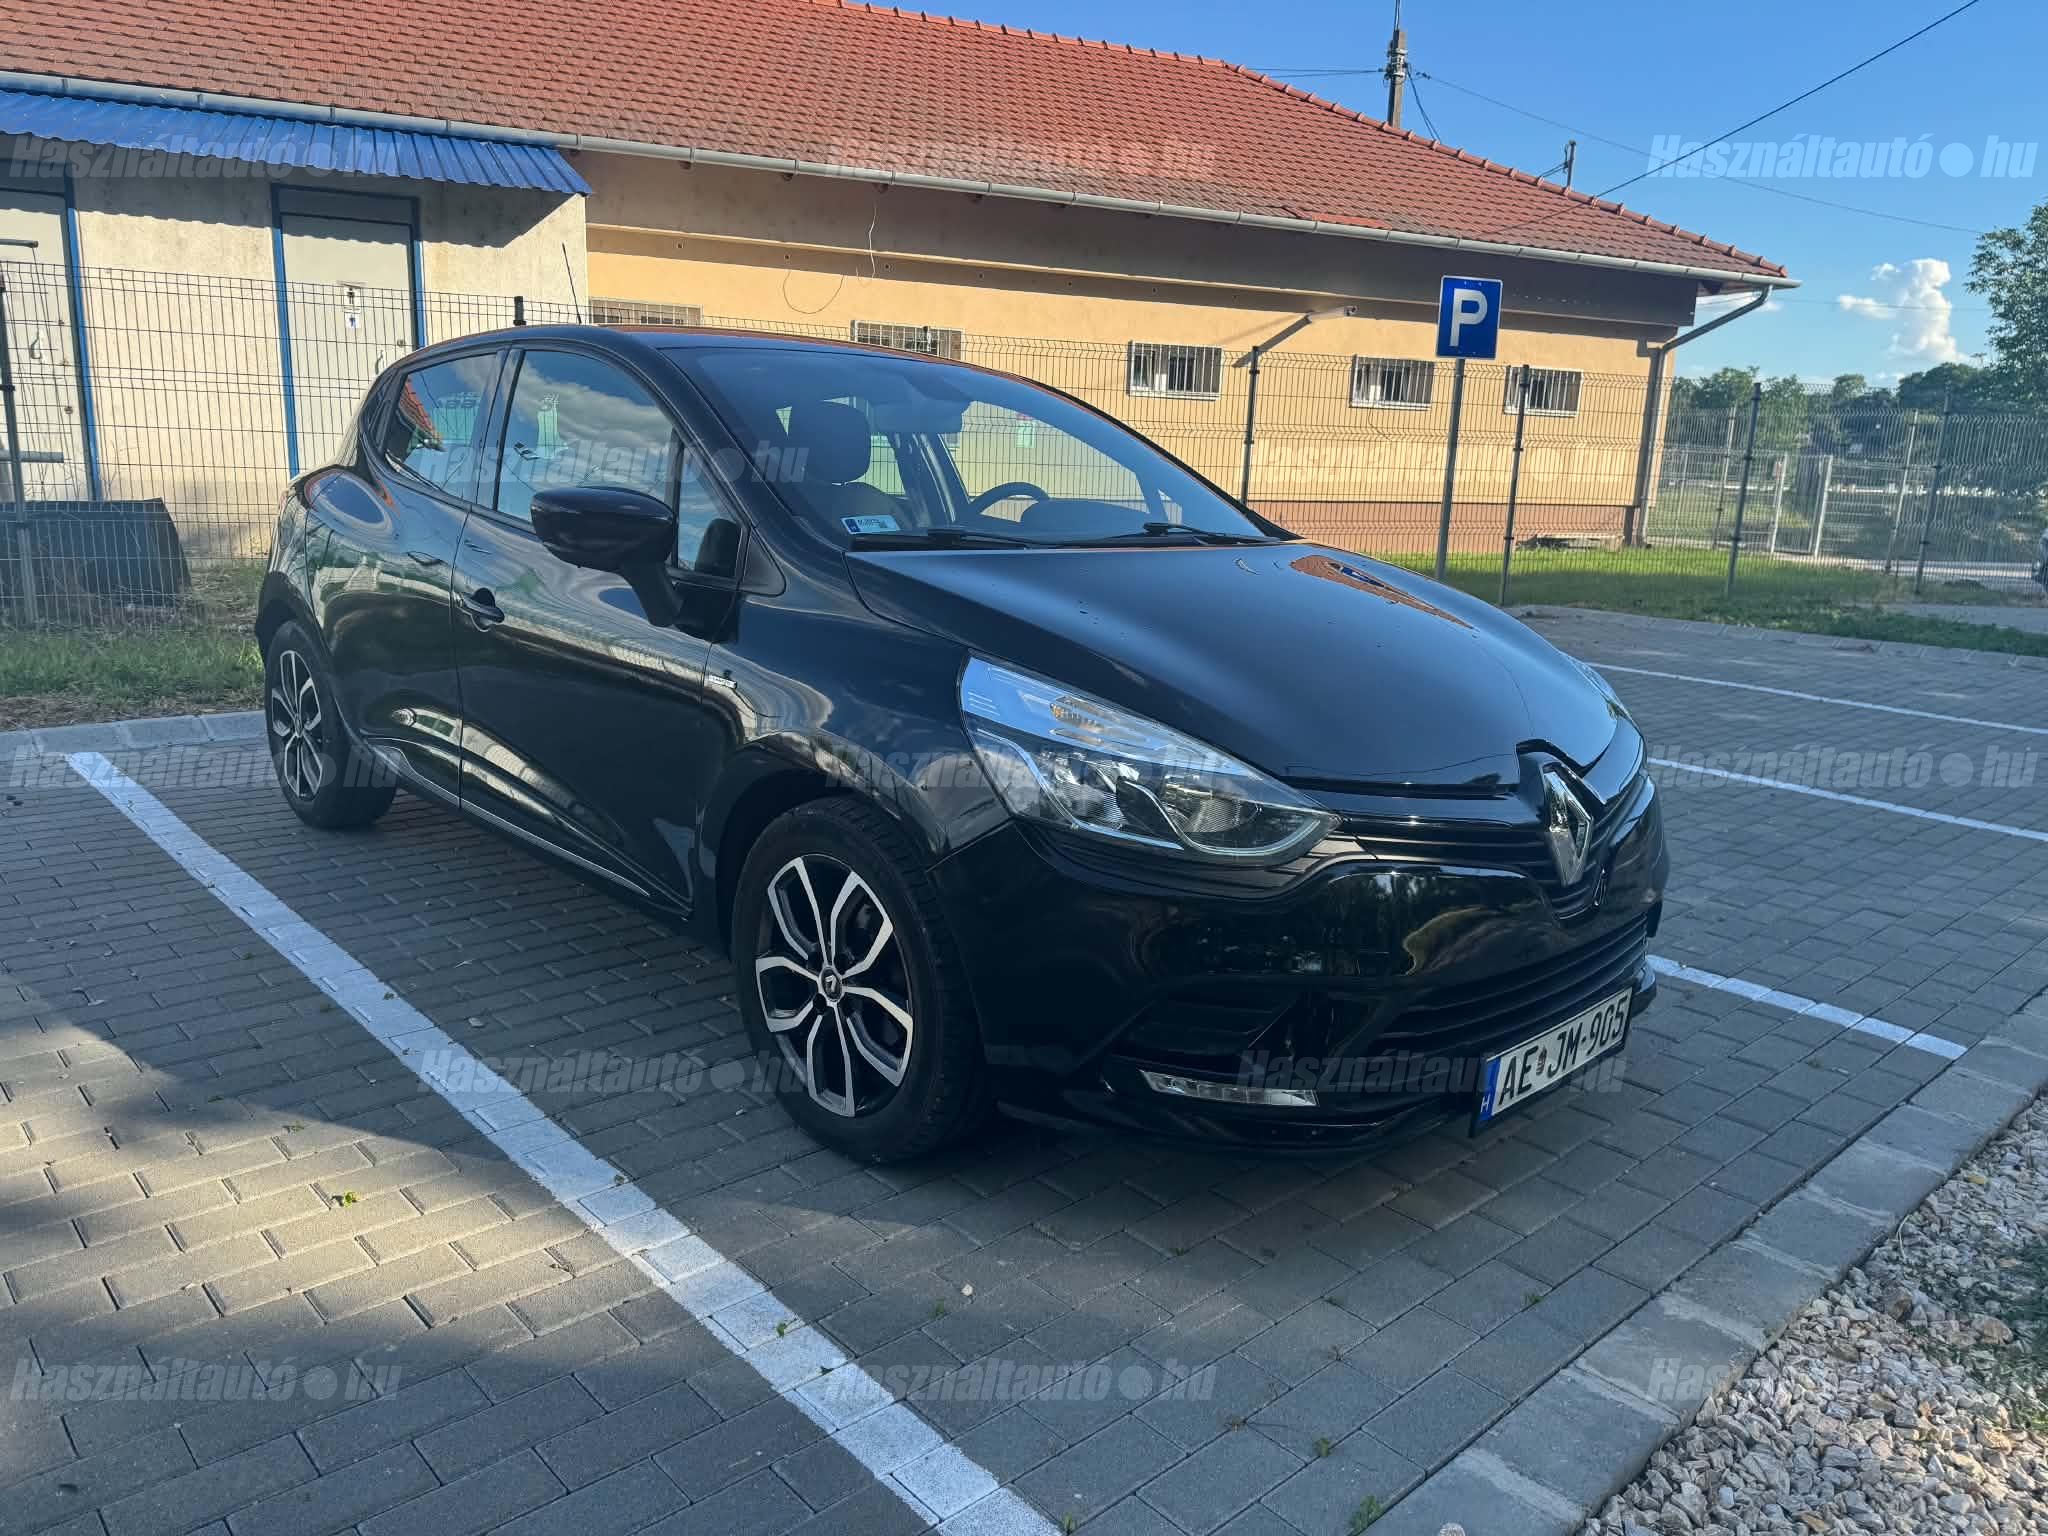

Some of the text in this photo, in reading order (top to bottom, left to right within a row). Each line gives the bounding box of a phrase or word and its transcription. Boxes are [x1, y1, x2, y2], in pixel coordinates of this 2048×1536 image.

[1449, 288, 1488, 347] P
[1480, 1095, 1491, 1113] H
[1499, 1046, 1538, 1105] AE
